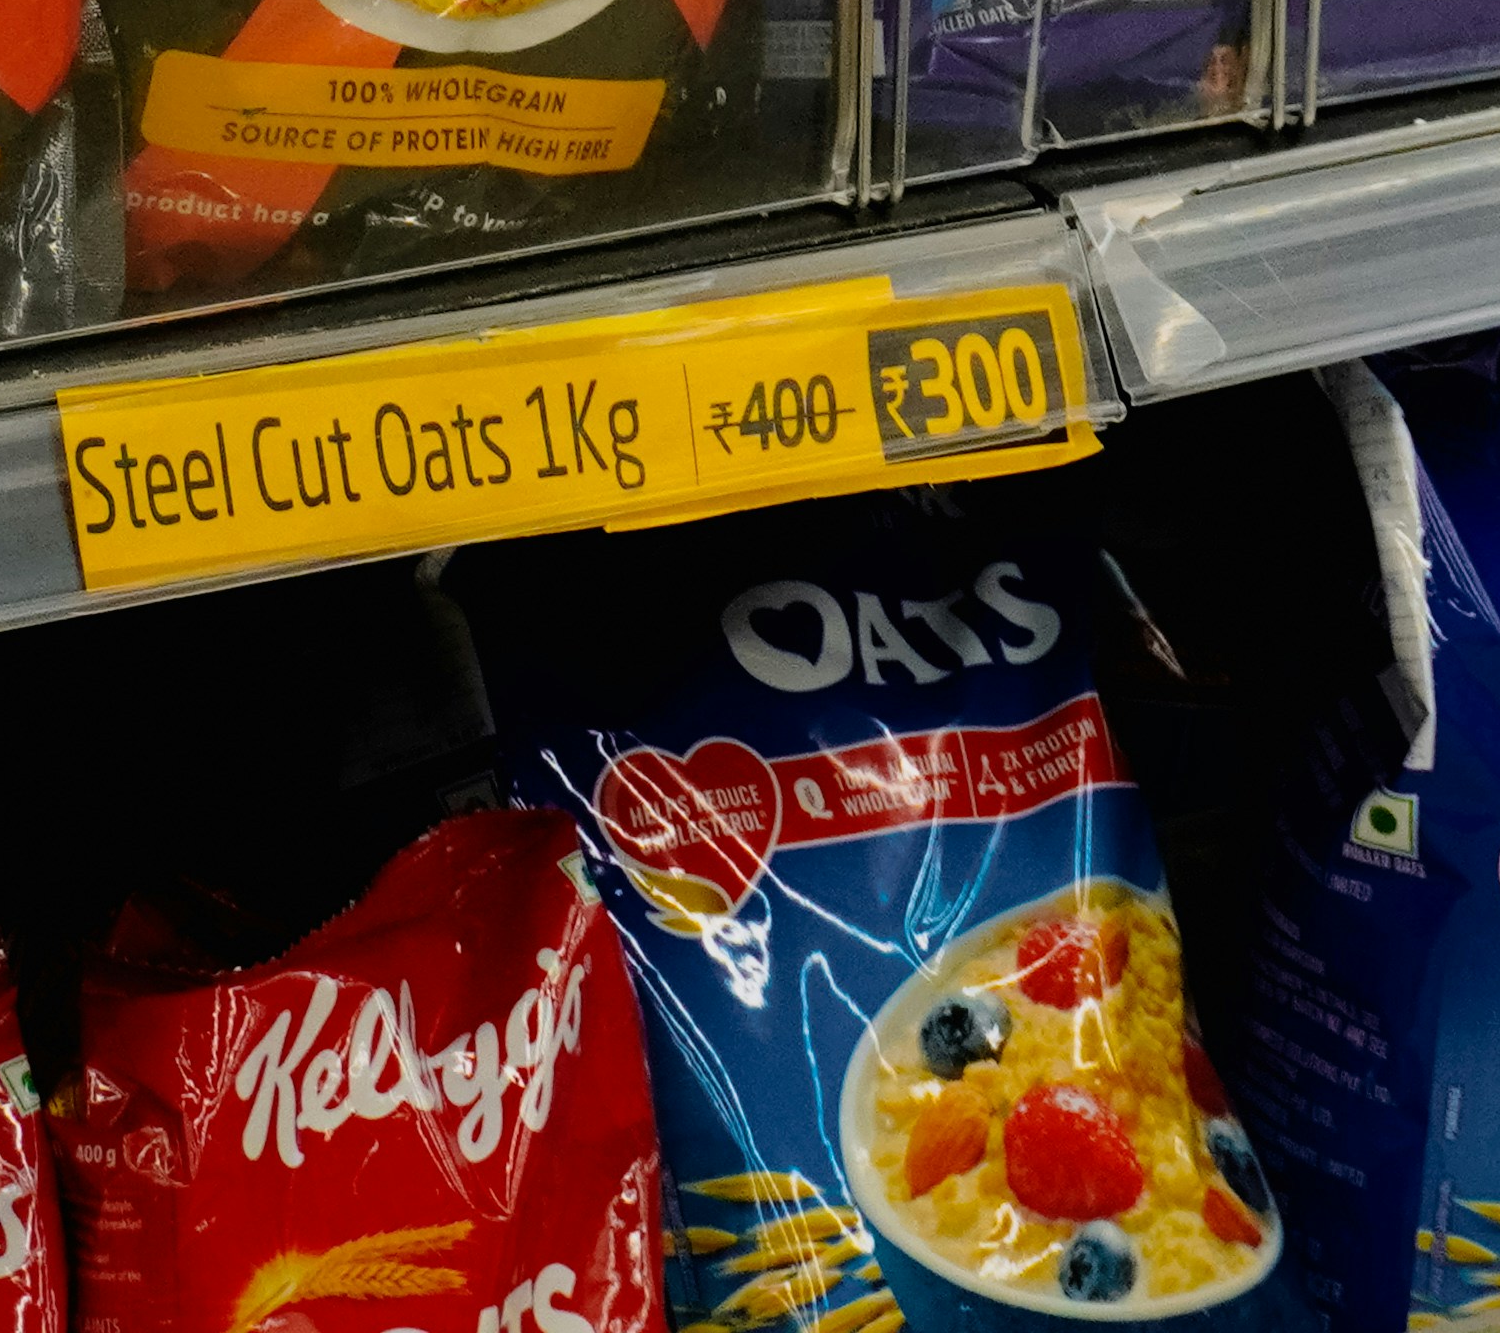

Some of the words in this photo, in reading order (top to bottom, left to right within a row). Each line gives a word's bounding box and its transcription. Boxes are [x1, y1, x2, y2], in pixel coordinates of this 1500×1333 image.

[220, 120, 337, 150] SOURCE
[346, 128, 383, 152] OF
[390, 129, 490, 153] PROTEIN
[326, 78, 395, 105] 100%
[404, 80, 567, 114] WHOLEGRAIN
[124, 190, 243, 222] product
[251, 204, 307, 226] has
[881, 326, 1049, 441] ₹300
[72, 418, 236, 535] Steel
[250, 409, 365, 515] Cut
[374, 398, 515, 499] Oats
[523, 378, 643, 490] 1Kg
[719, 560, 1062, 694] OATS
[234, 973, 592, 1169] Kellogg's
